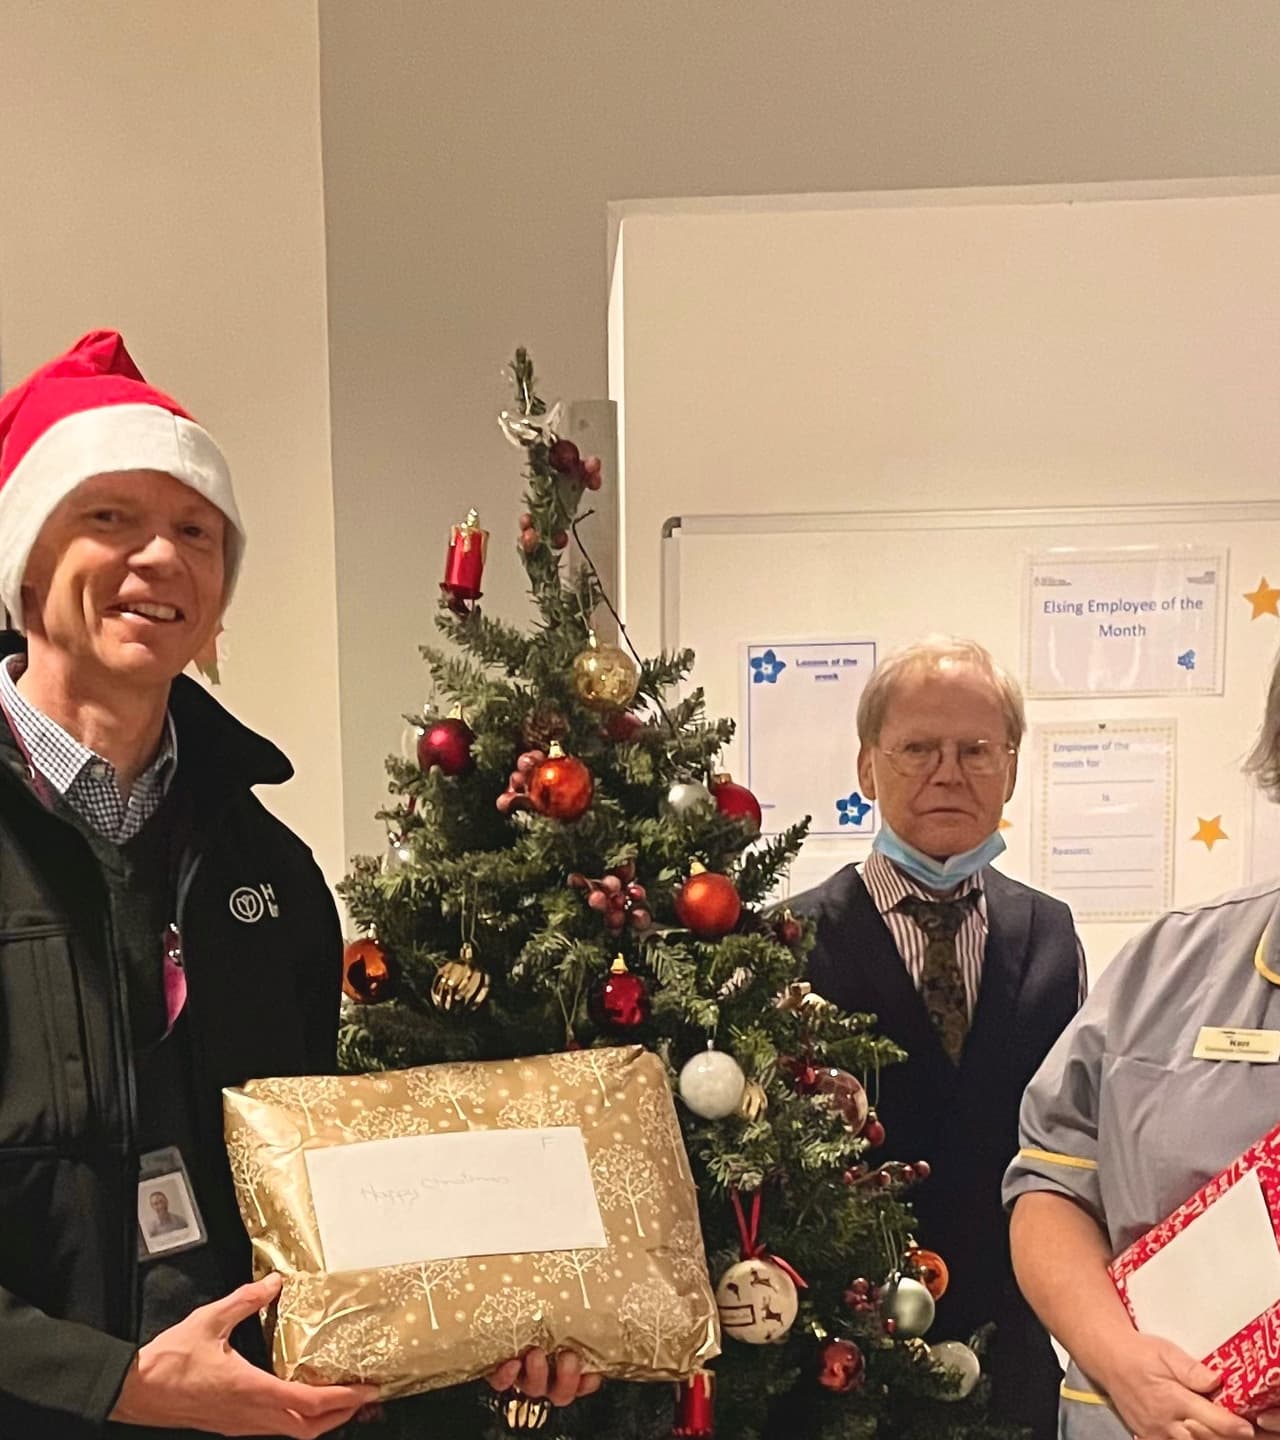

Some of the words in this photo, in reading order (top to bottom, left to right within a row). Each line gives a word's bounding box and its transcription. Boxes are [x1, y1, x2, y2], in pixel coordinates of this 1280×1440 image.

[1044, 600, 1083, 616] Elsing
[1088, 599, 1156, 615] Employee
[1162, 596, 1175, 610] of
[1180, 597, 1203, 610] the
[1098, 624, 1146, 637] Month
[815, 673, 839, 681] week
[1053, 743, 1099, 753] Employee
[1102, 741, 1112, 750] of
[1115, 742, 1129, 750] the
[1053, 759, 1084, 768] month
[1086, 758, 1100, 768] for
